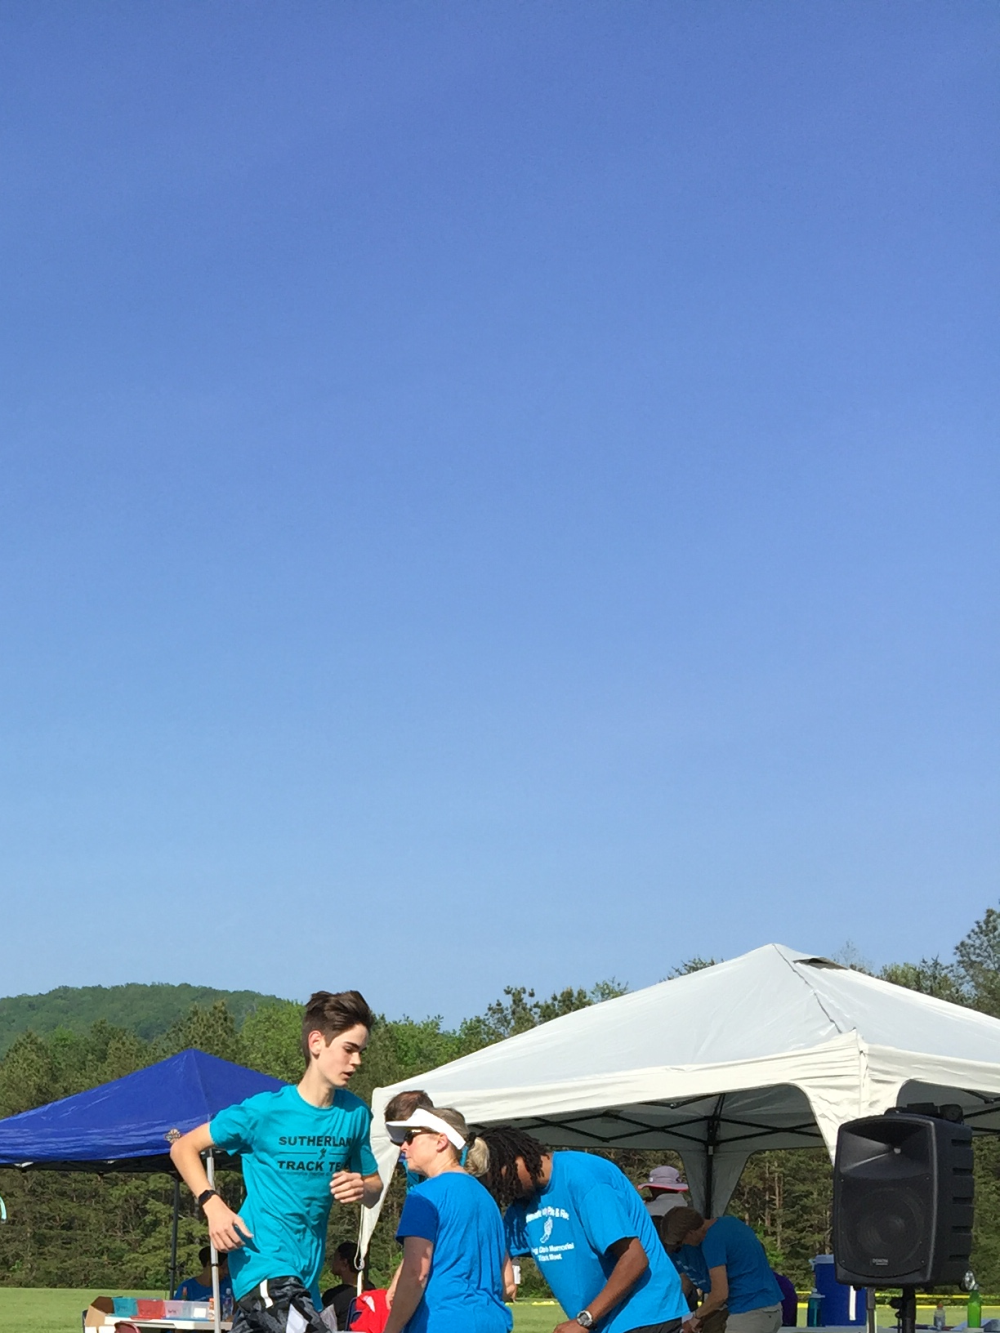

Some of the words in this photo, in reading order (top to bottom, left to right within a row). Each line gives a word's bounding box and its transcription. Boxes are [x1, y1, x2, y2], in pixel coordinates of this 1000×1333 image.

[278, 1135, 352, 1147] SUTHERLAN
[277, 1160, 325, 1172] TRACK
[328, 1161, 350, 1172] TEA
